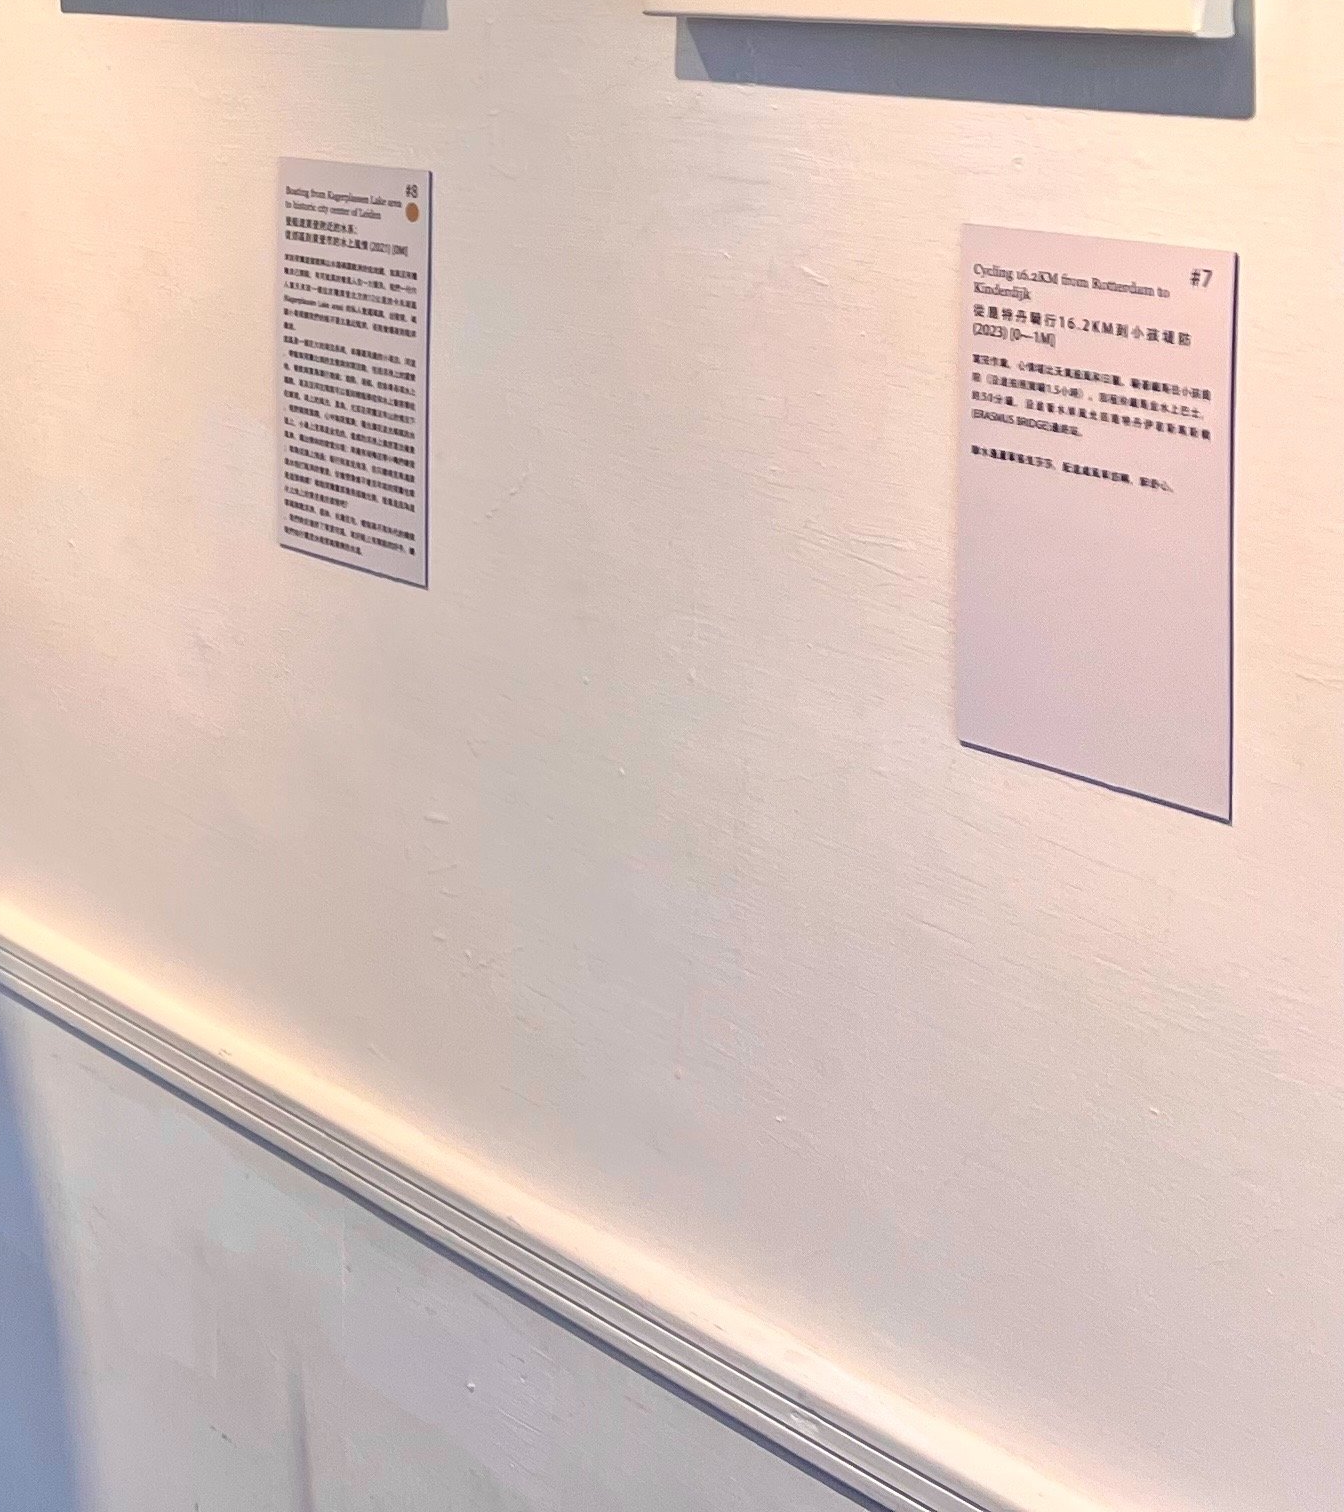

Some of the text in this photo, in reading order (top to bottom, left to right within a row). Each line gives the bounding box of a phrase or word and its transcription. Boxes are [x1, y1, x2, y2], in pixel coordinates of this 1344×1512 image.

[973, 263, 1014, 282] Cycling
[1060, 272, 1090, 289] from
[1091, 276, 1155, 297] Rotterdam
[1156, 286, 1171, 299] to
[1190, 268, 1213, 288] #7
[973, 281, 1032, 301] Kinderdijk
[972, 322, 1009, 341] (2023)
